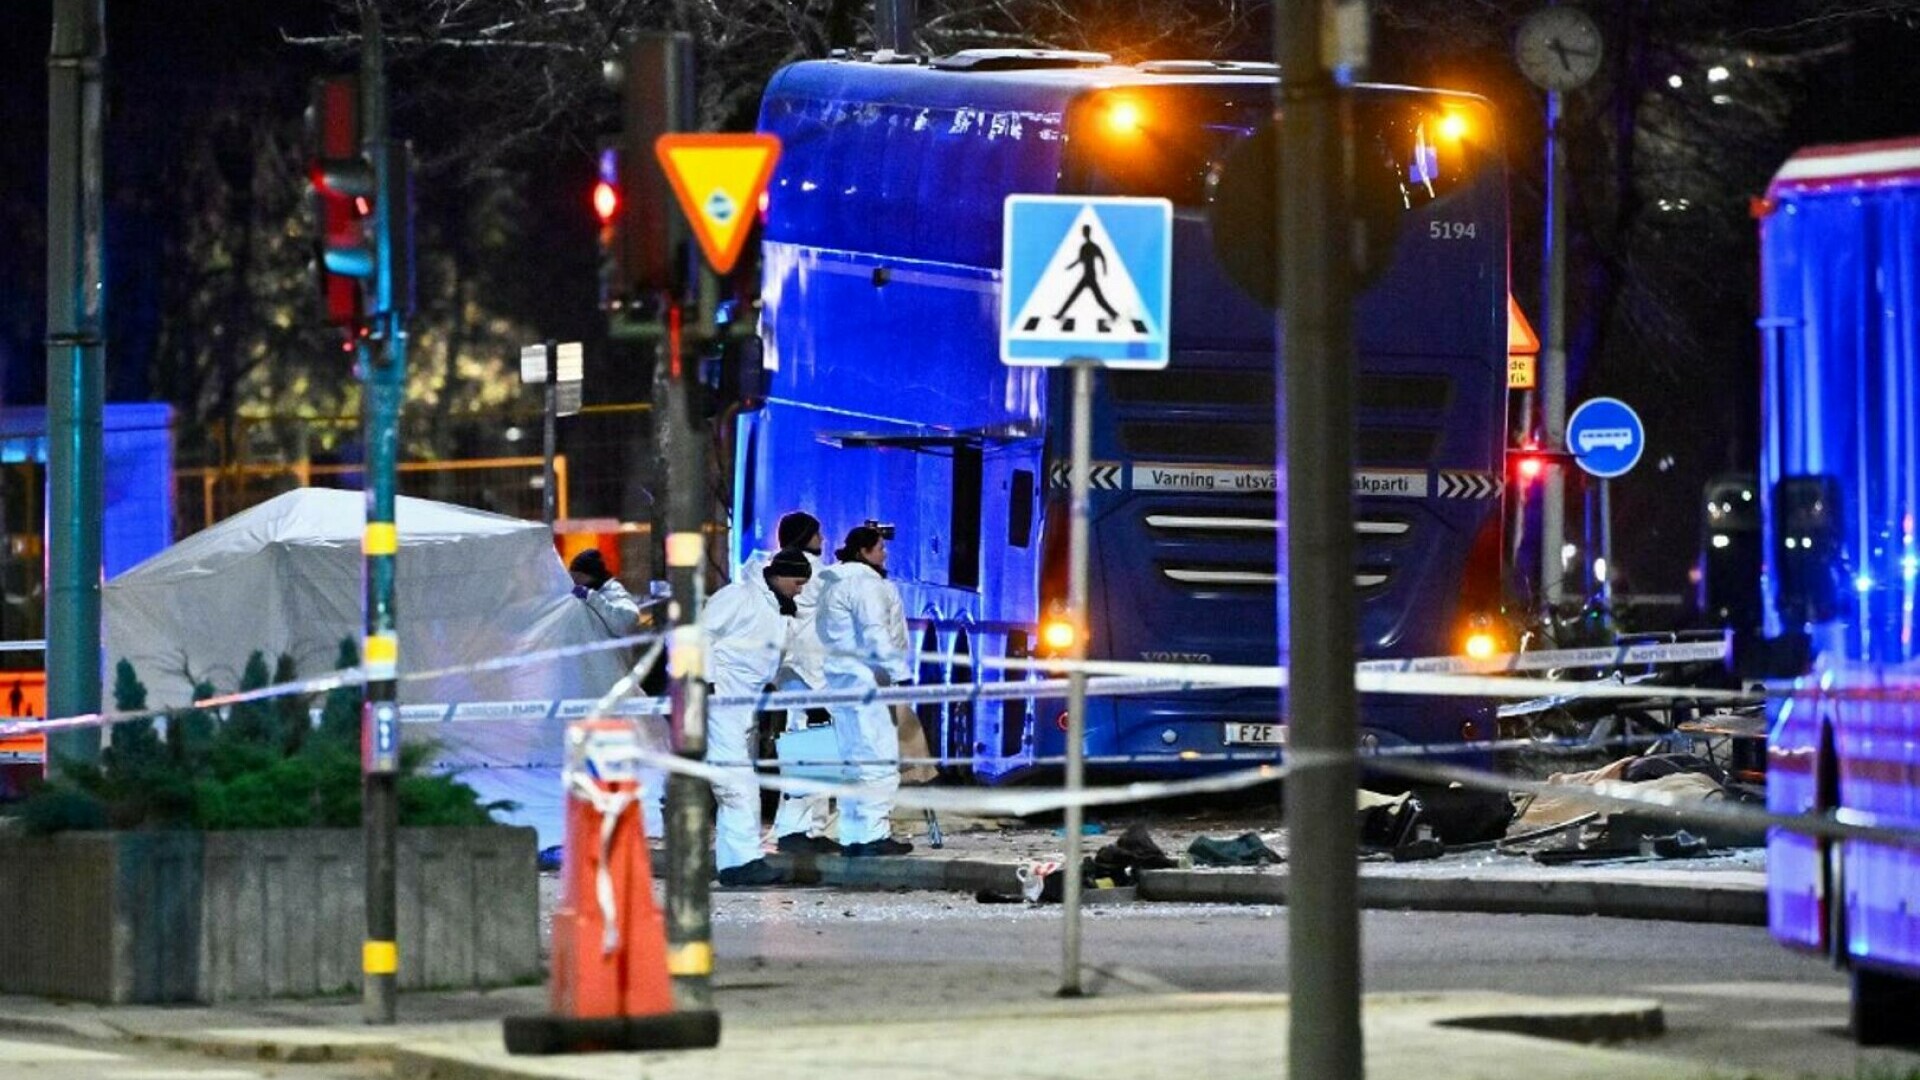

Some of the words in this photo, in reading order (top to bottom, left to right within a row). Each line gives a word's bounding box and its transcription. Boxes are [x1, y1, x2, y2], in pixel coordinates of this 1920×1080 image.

[1430, 221, 1476, 239] 5194
[1152, 470, 1214, 489] Varning
[1239, 725, 1272, 741] FZF
